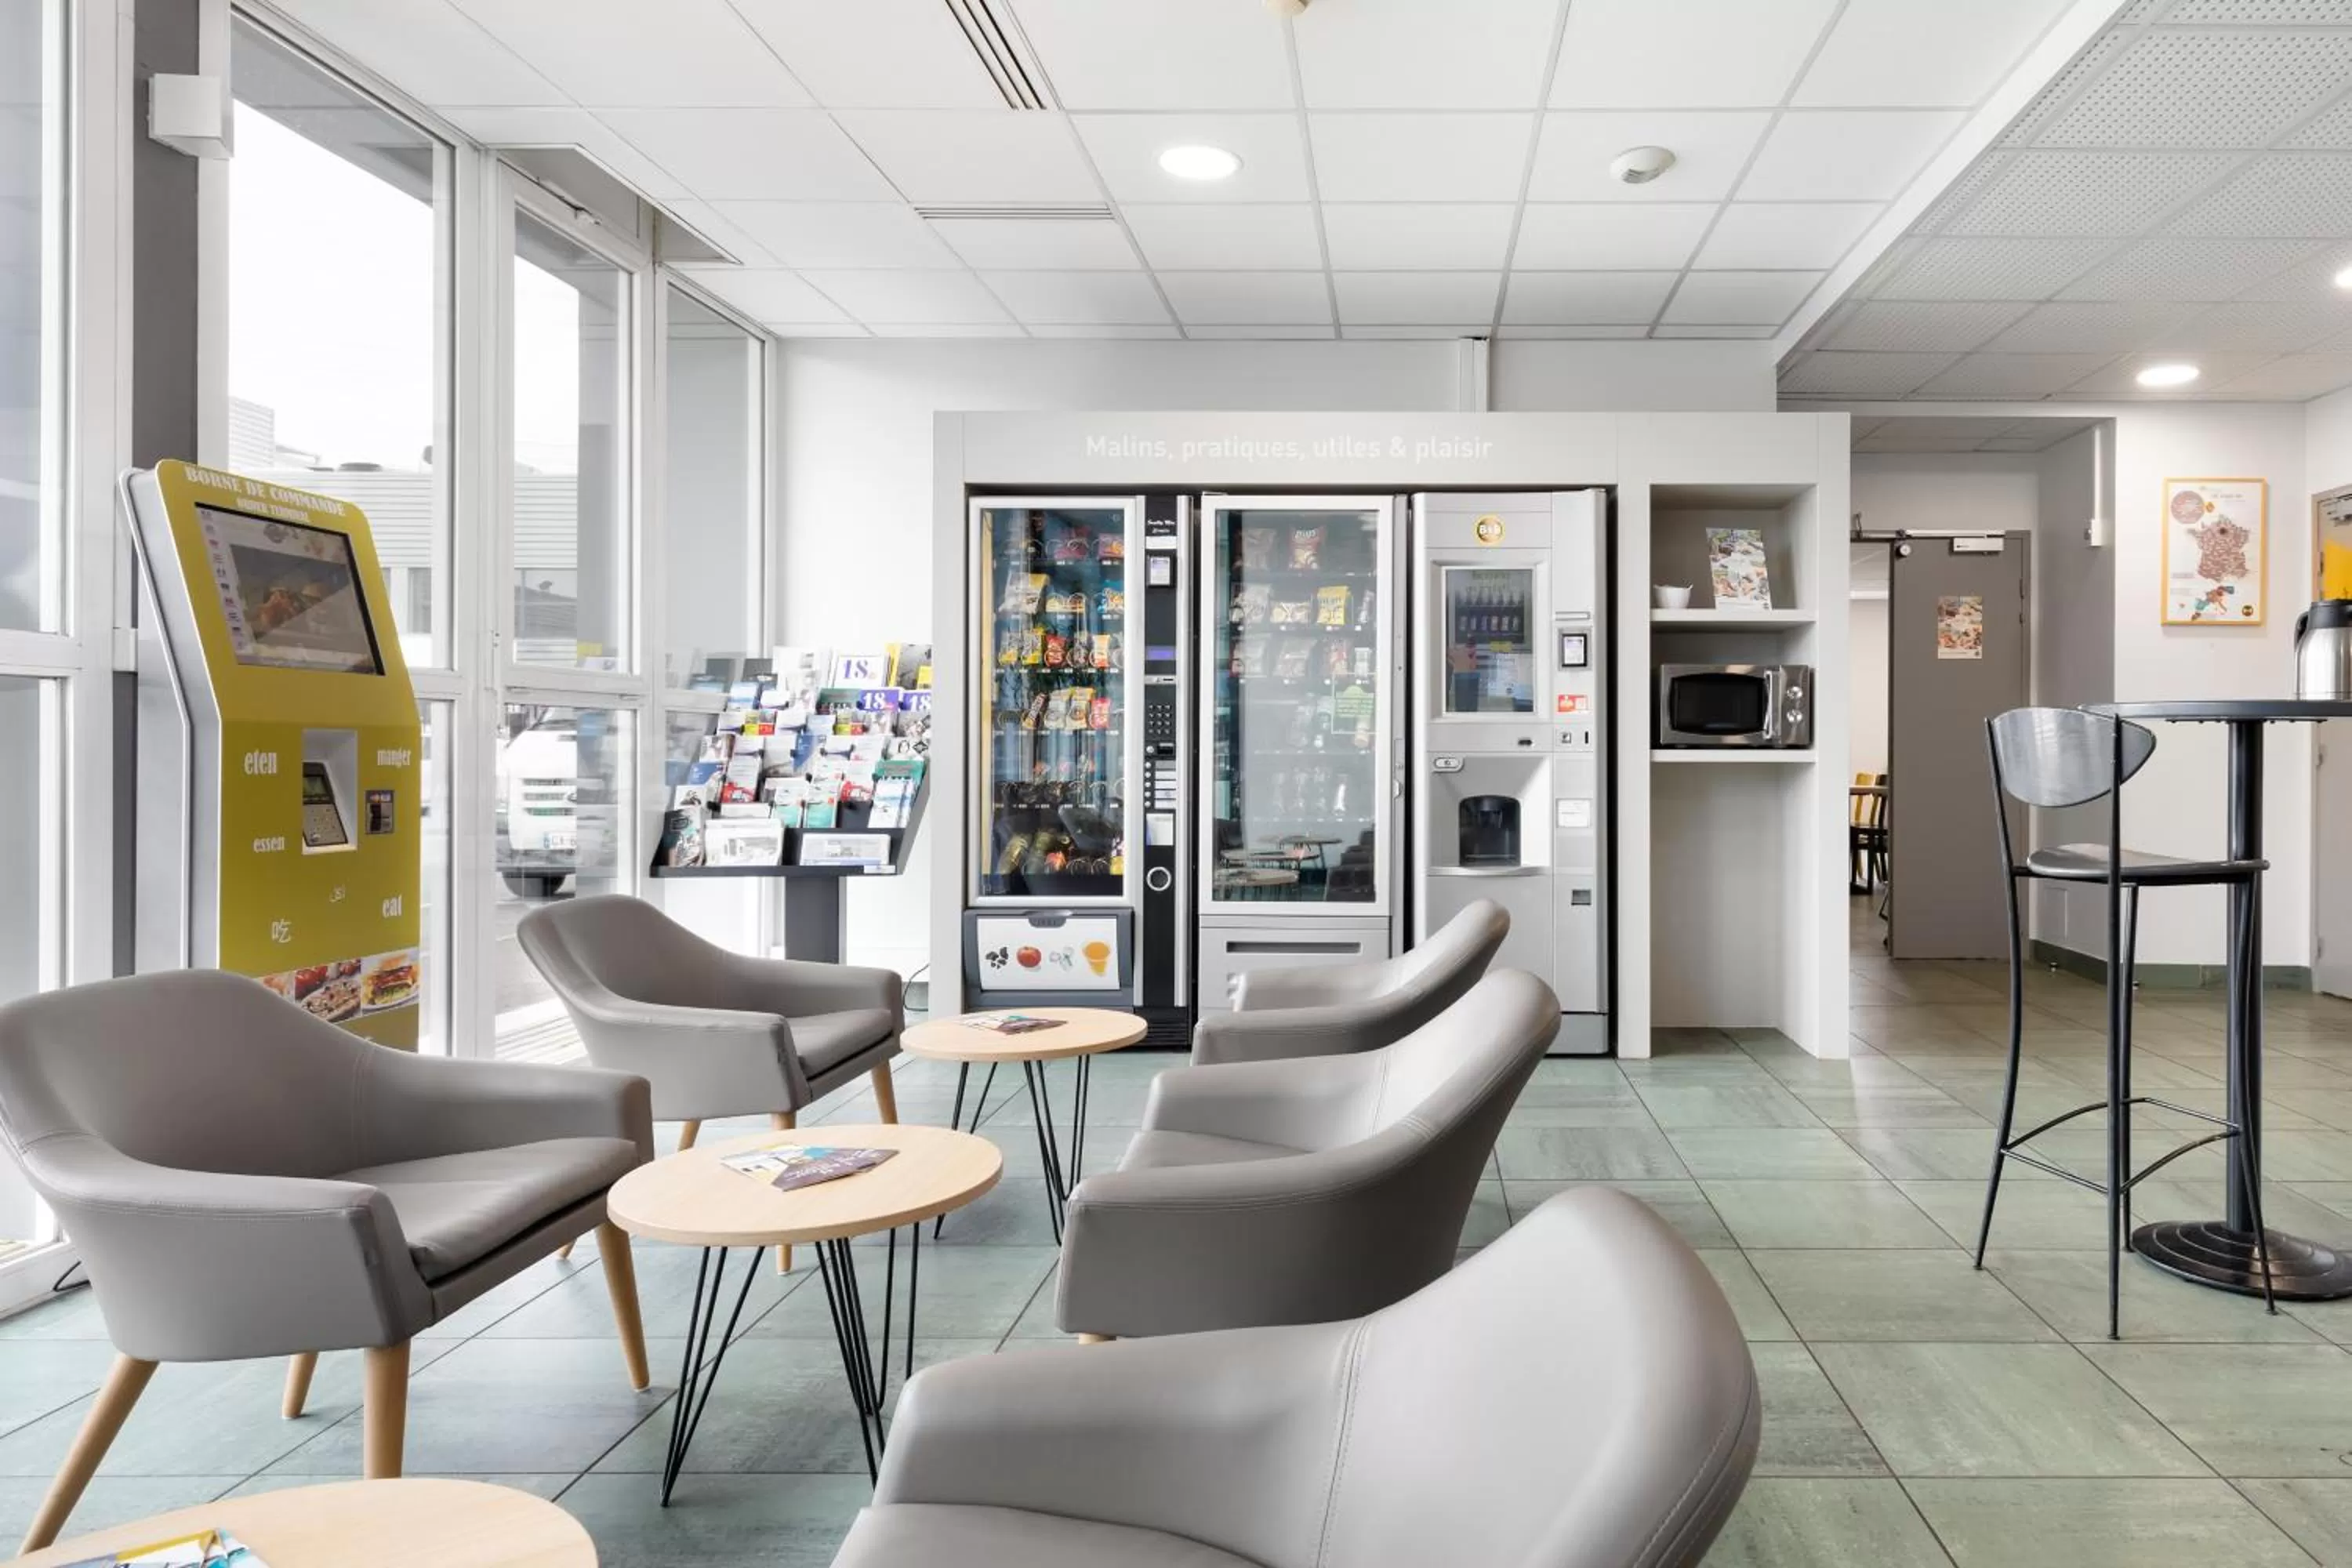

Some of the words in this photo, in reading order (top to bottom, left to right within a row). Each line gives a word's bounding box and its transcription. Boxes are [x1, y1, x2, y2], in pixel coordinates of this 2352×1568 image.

[1085, 435, 1173, 460] Malins,
[1181, 436, 1307, 463] pratiques,
[1313, 435, 1380, 458] utiles
[1389, 436, 1406, 458] &
[1415, 435, 1494, 463] plaisir
[183, 465, 242, 493] BORNE
[246, 481, 265, 499] DE
[270, 487, 346, 517] COMMANDE
[864, 692, 885, 710] 18
[244, 750, 278, 775] eten
[377, 748, 411, 768] manger
[253, 836, 285, 853] essen
[383, 895, 402, 918] eat
